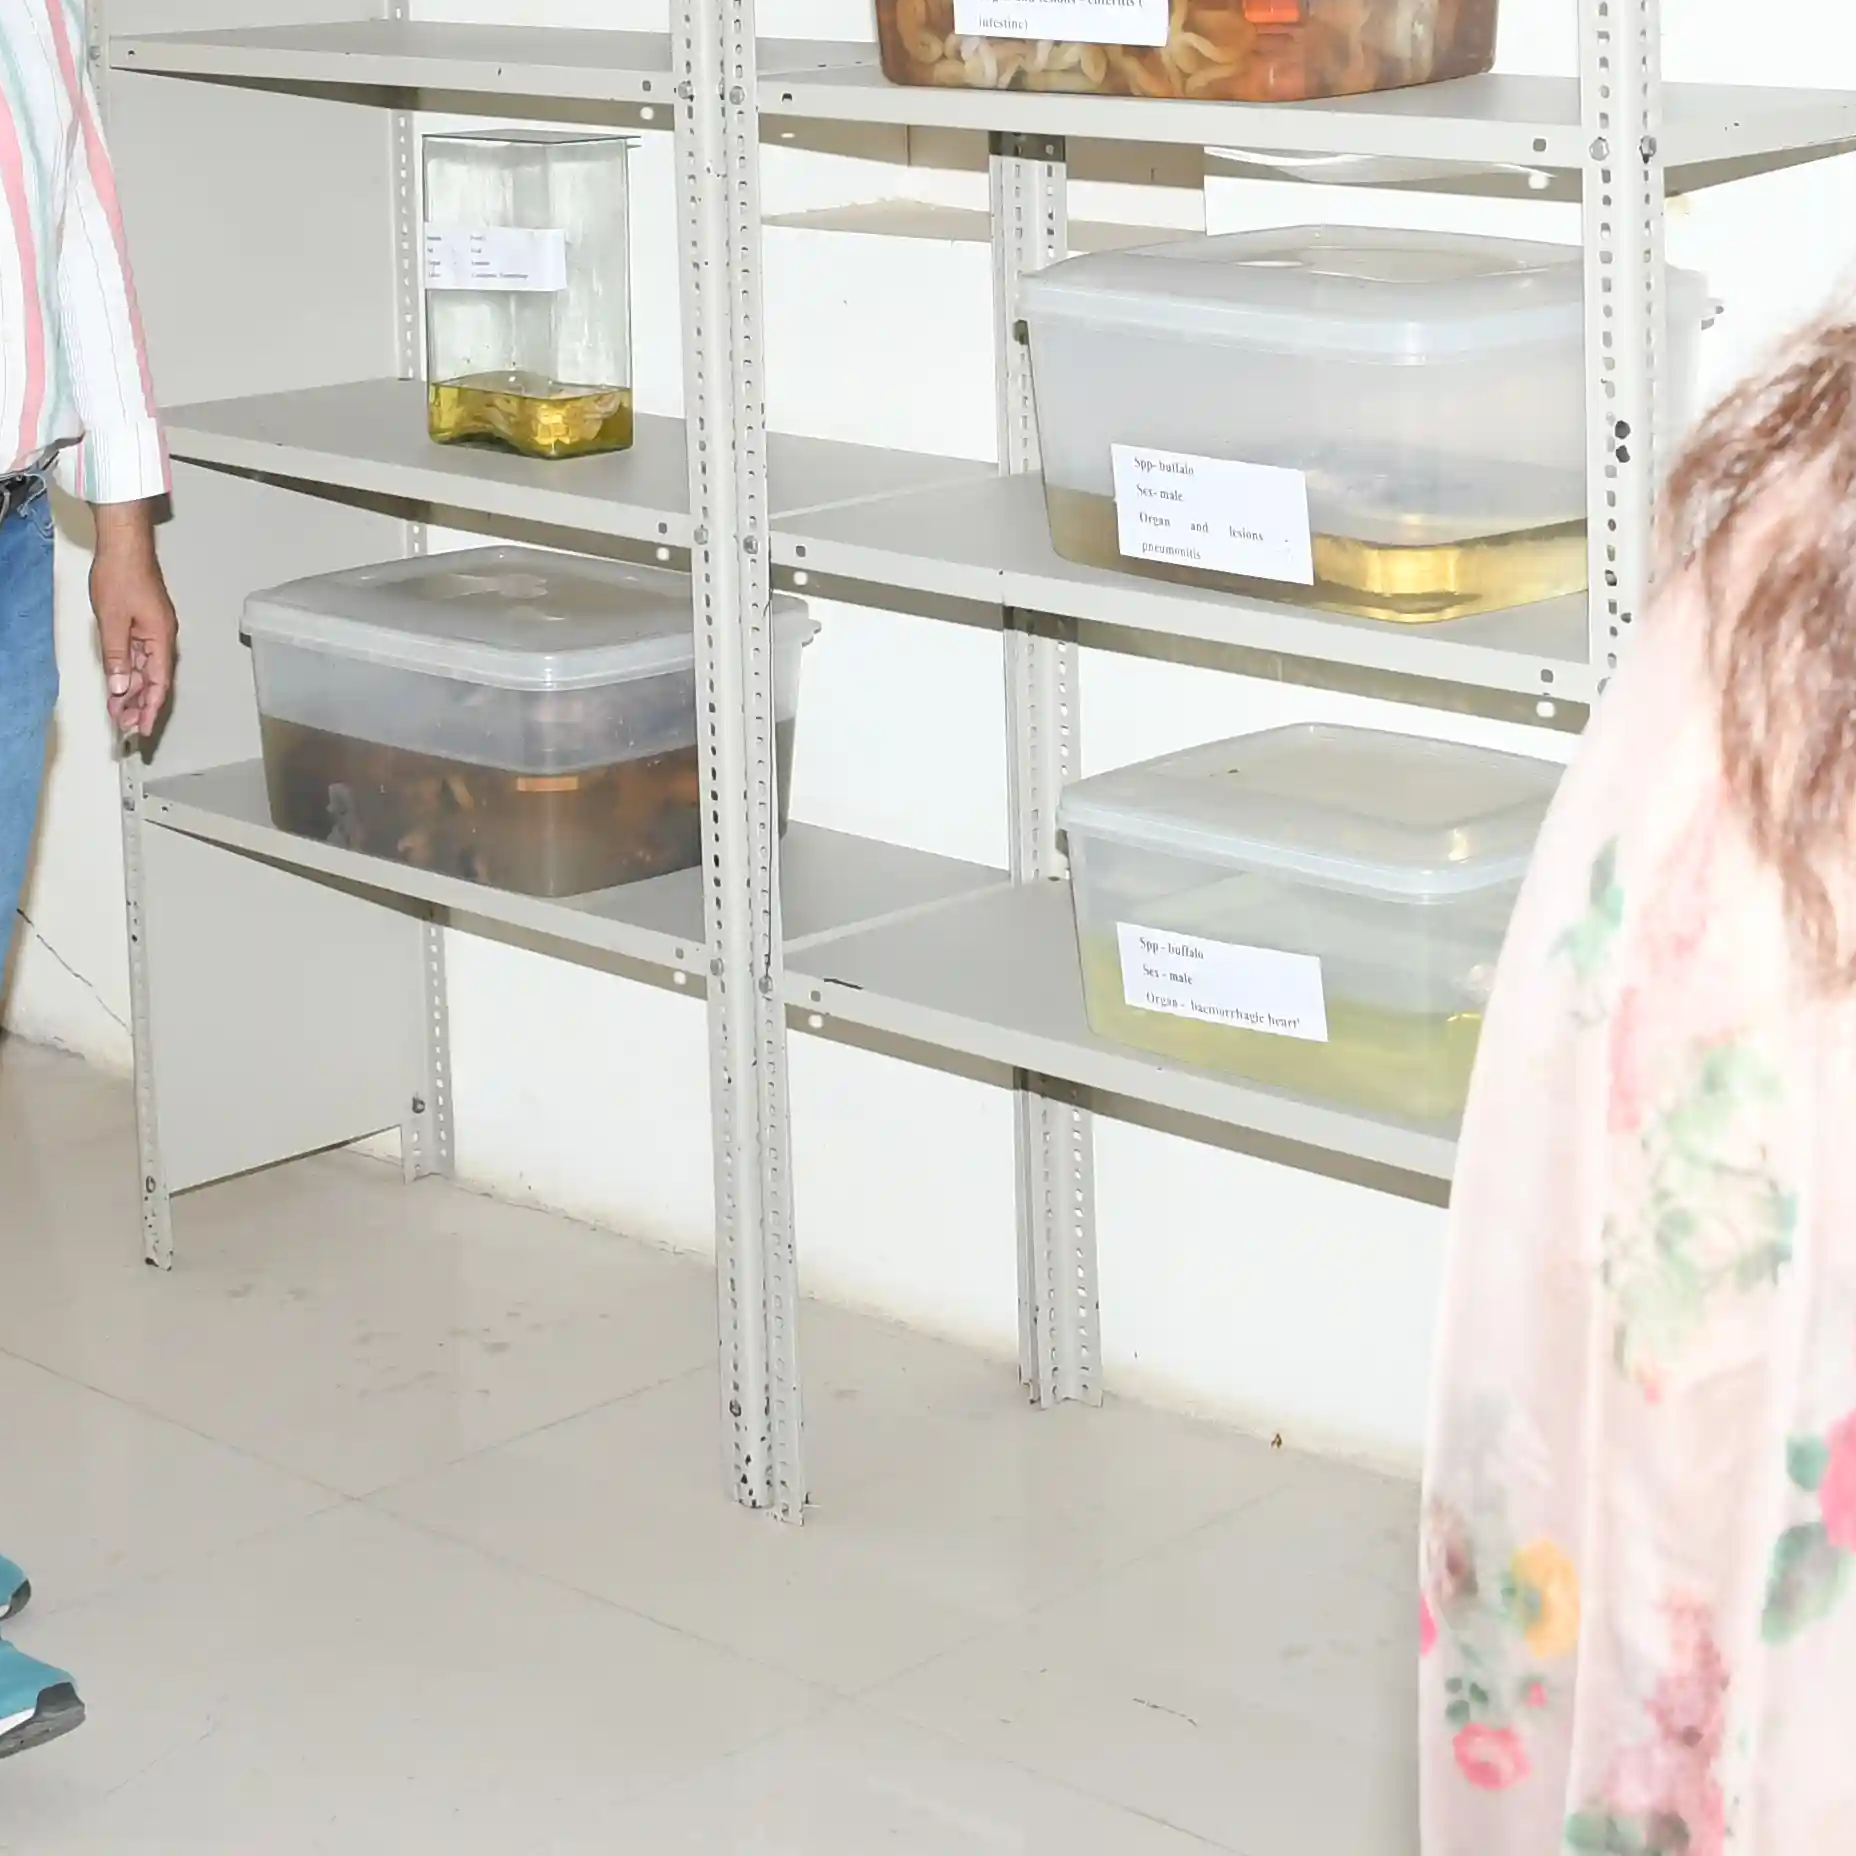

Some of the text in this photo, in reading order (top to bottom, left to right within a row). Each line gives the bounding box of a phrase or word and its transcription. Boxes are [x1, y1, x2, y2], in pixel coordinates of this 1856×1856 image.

[1159, 460, 1194, 475] buffalo
[1160, 488, 1183, 502] male
[1139, 511, 1170, 527] Organ
[1191, 521, 1208, 533] and
[1230, 525, 1263, 541] lesions
[1142, 541, 1201, 560] pneumonitis
[1140, 937, 1159, 953] Spp
[1168, 943, 1204, 960] buffalo
[1143, 964, 1159, 978] Sex
[1170, 971, 1192, 985] male
[1146, 992, 1178, 1008] Organ
[1191, 999, 1264, 1024] haemorrhagic
